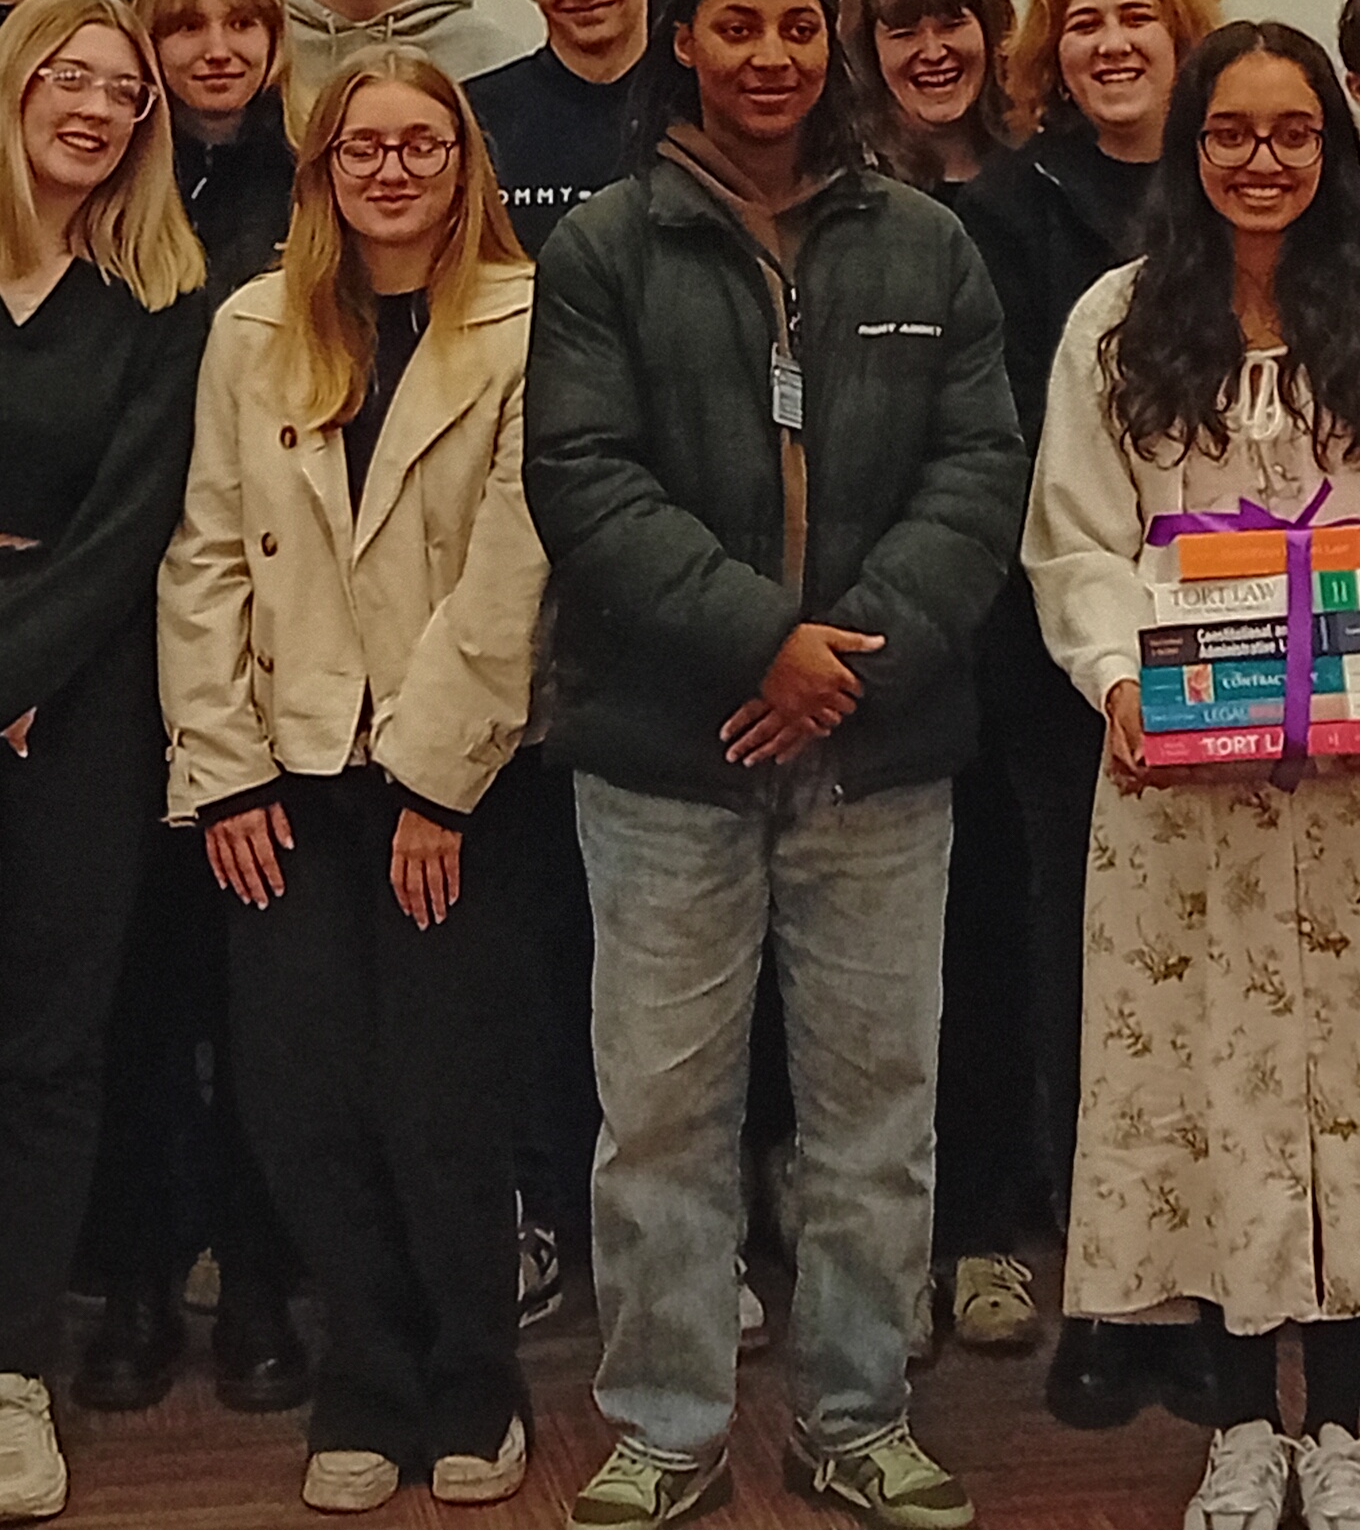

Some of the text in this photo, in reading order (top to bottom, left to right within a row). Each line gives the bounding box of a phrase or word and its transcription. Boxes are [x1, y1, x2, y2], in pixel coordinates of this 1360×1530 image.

[497, 186, 573, 206] OMMY
[1170, 585, 1227, 607] TORT
[1232, 582, 1277, 603] LAW
[1200, 734, 1260, 755] TORT
